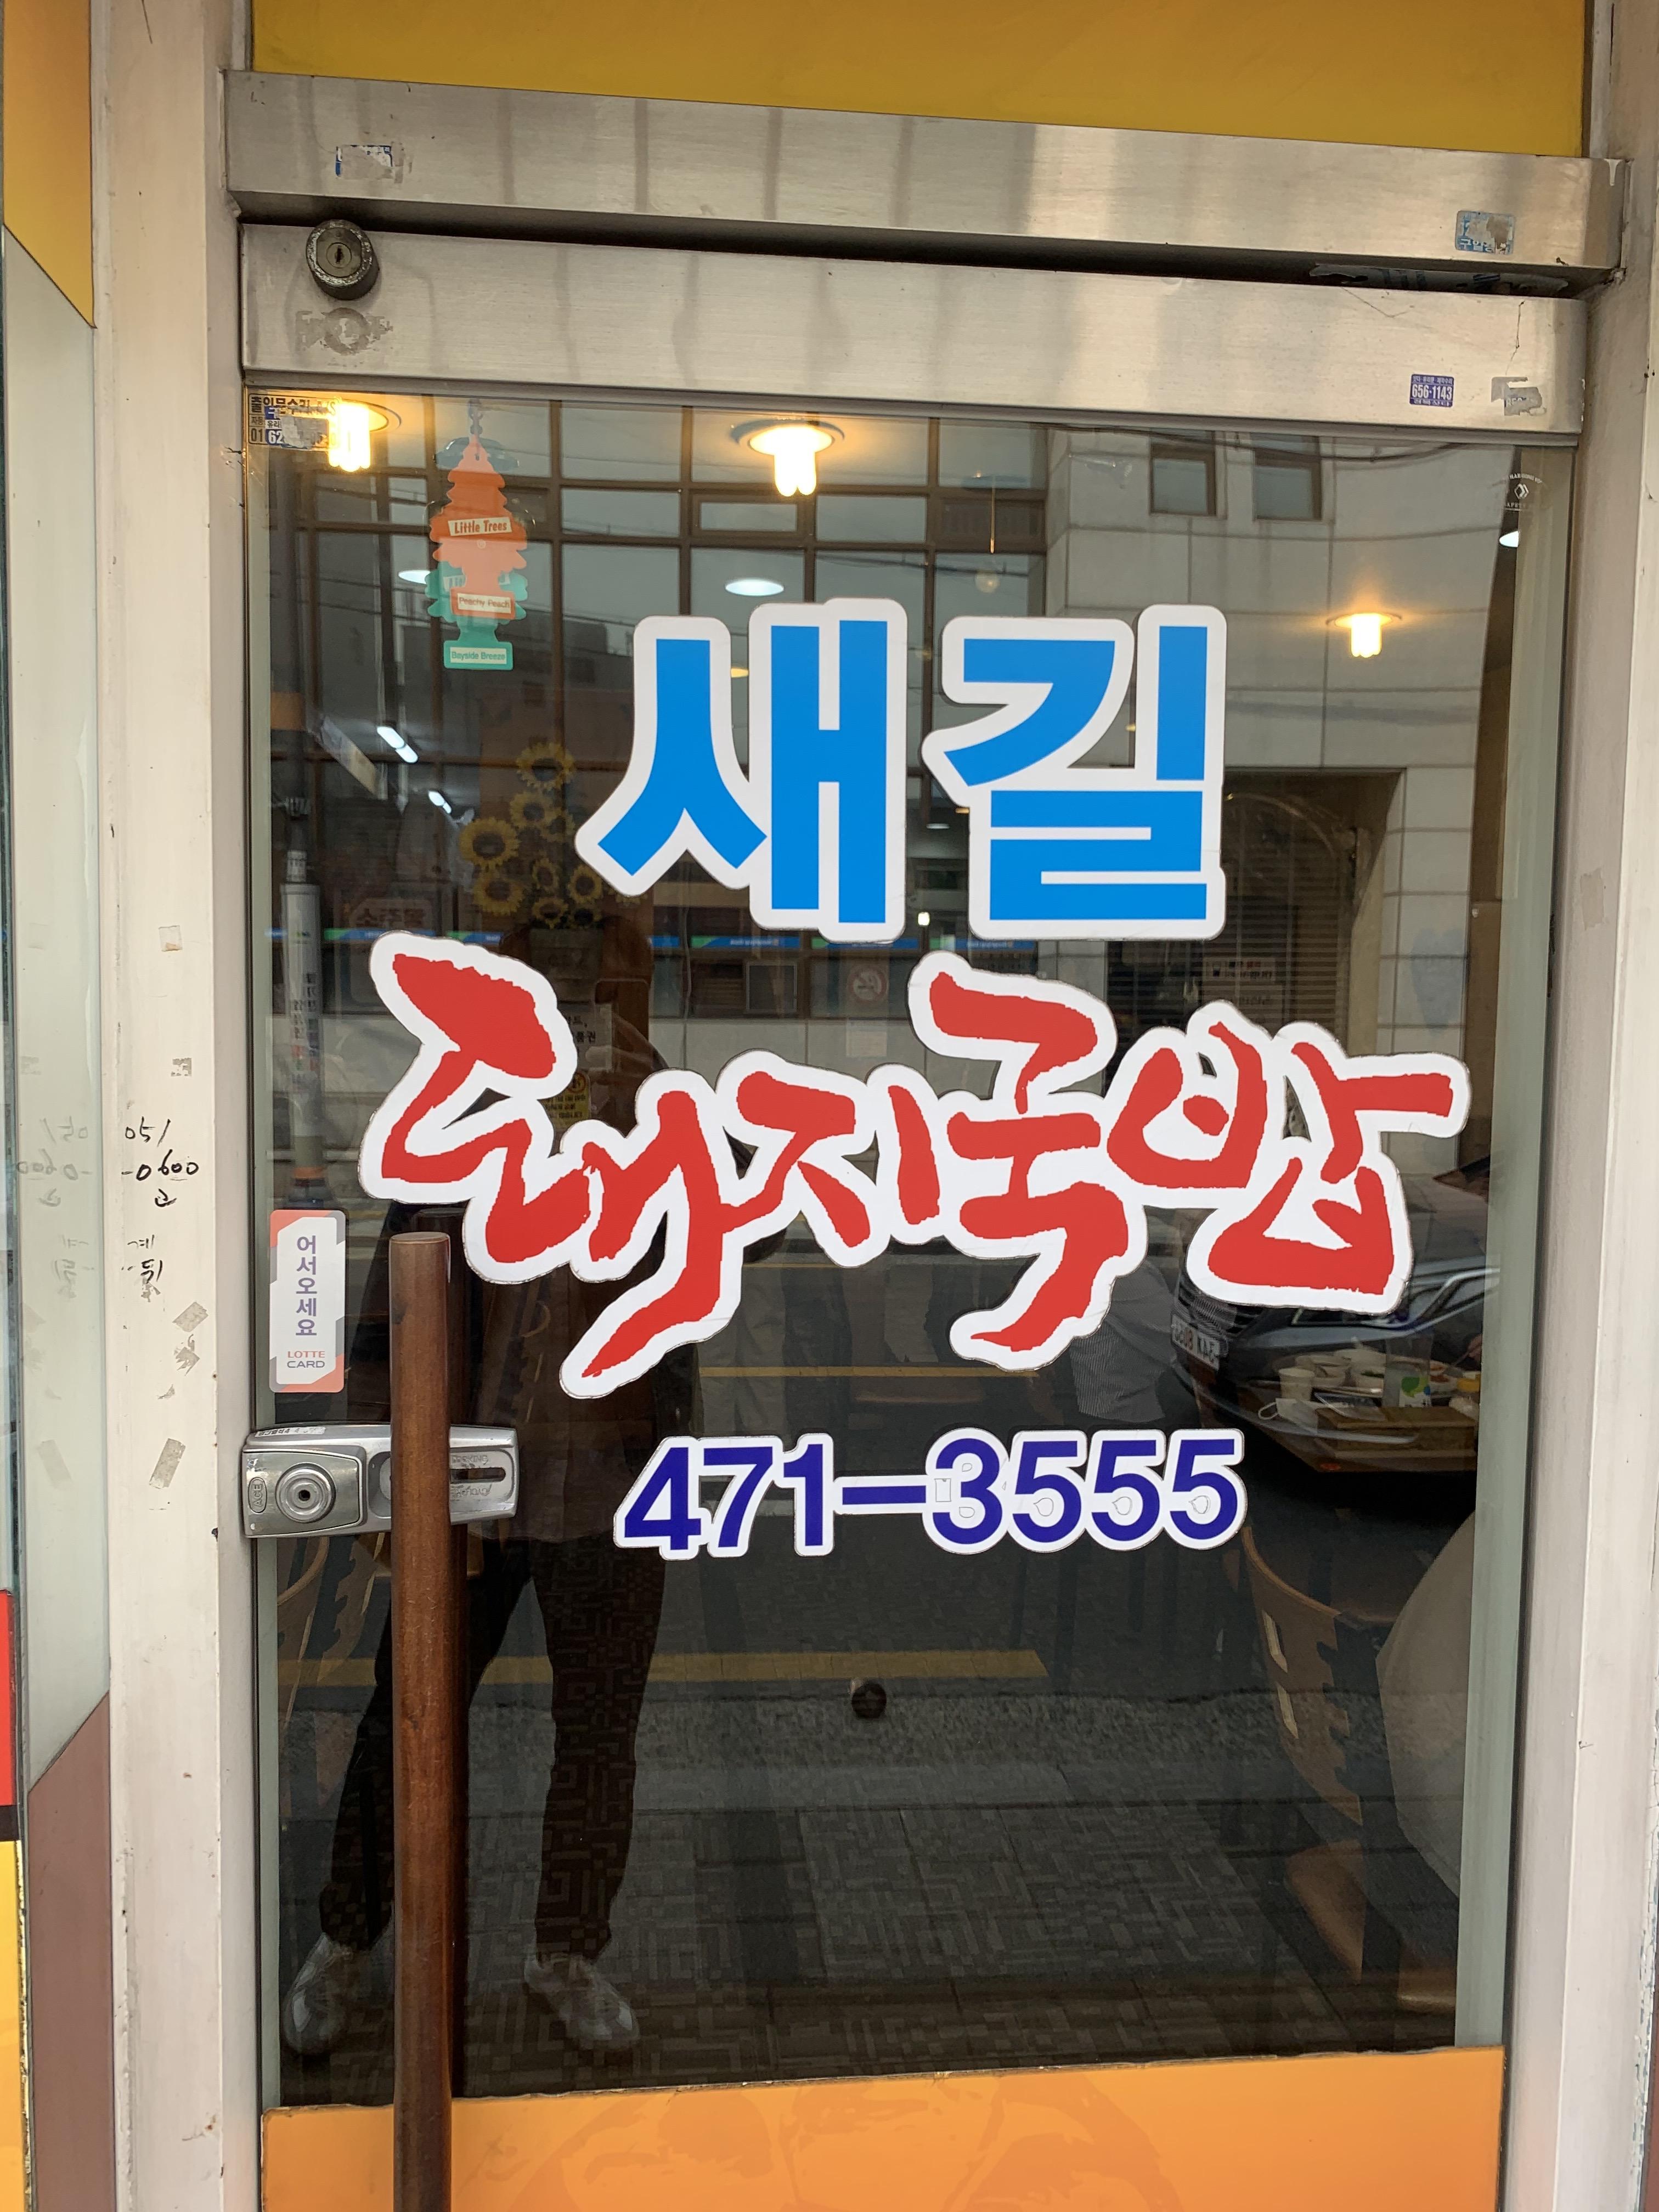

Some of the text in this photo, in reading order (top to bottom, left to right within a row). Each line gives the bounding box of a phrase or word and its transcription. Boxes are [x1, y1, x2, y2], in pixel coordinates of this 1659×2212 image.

[454, 520, 507, 534] Little Trees
[597, 620, 1208, 923] 새길
[381, 953, 1454, 1378] 돼지국밥
[295, 1235, 318, 1336] 어서오세요
[624, 1437, 1238, 1551] 471-3555
